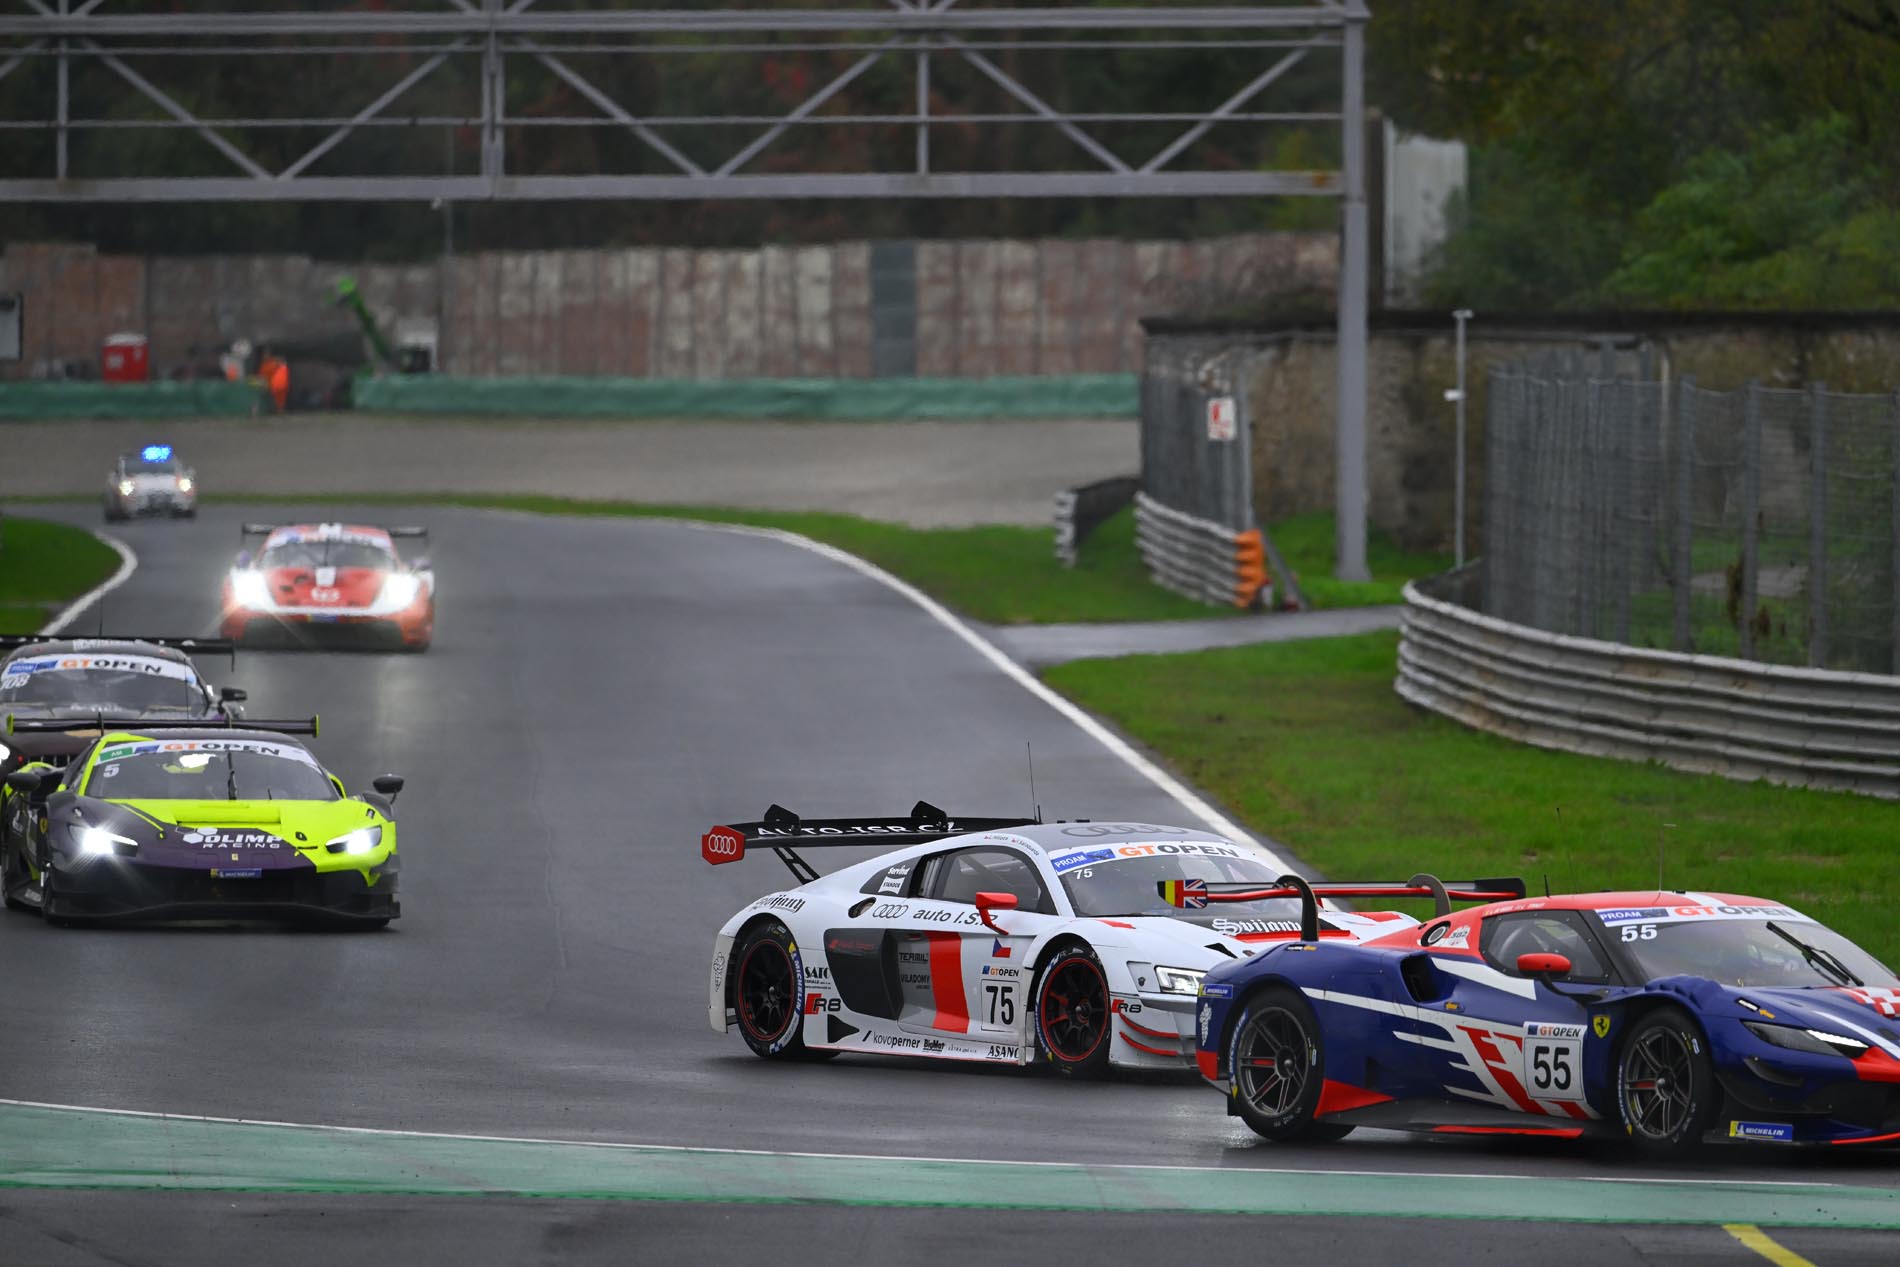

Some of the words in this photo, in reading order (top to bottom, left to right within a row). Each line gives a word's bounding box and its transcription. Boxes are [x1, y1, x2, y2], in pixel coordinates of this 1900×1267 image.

[103, 763, 120, 778] 5
[1055, 854, 1087, 868] PROAM
[1073, 868, 1093, 880] 75
[913, 909, 952, 922] auto
[1600, 909, 1642, 921] PROAM
[1621, 924, 1658, 942] 55
[812, 998, 841, 1012] R8
[986, 985, 1014, 1025] 75
[1118, 1002, 1142, 1013] R8
[873, 1032, 921, 1049] kovoperner
[1533, 1045, 1571, 1090] 55
[1745, 1127, 1785, 1136] MICHELIN
